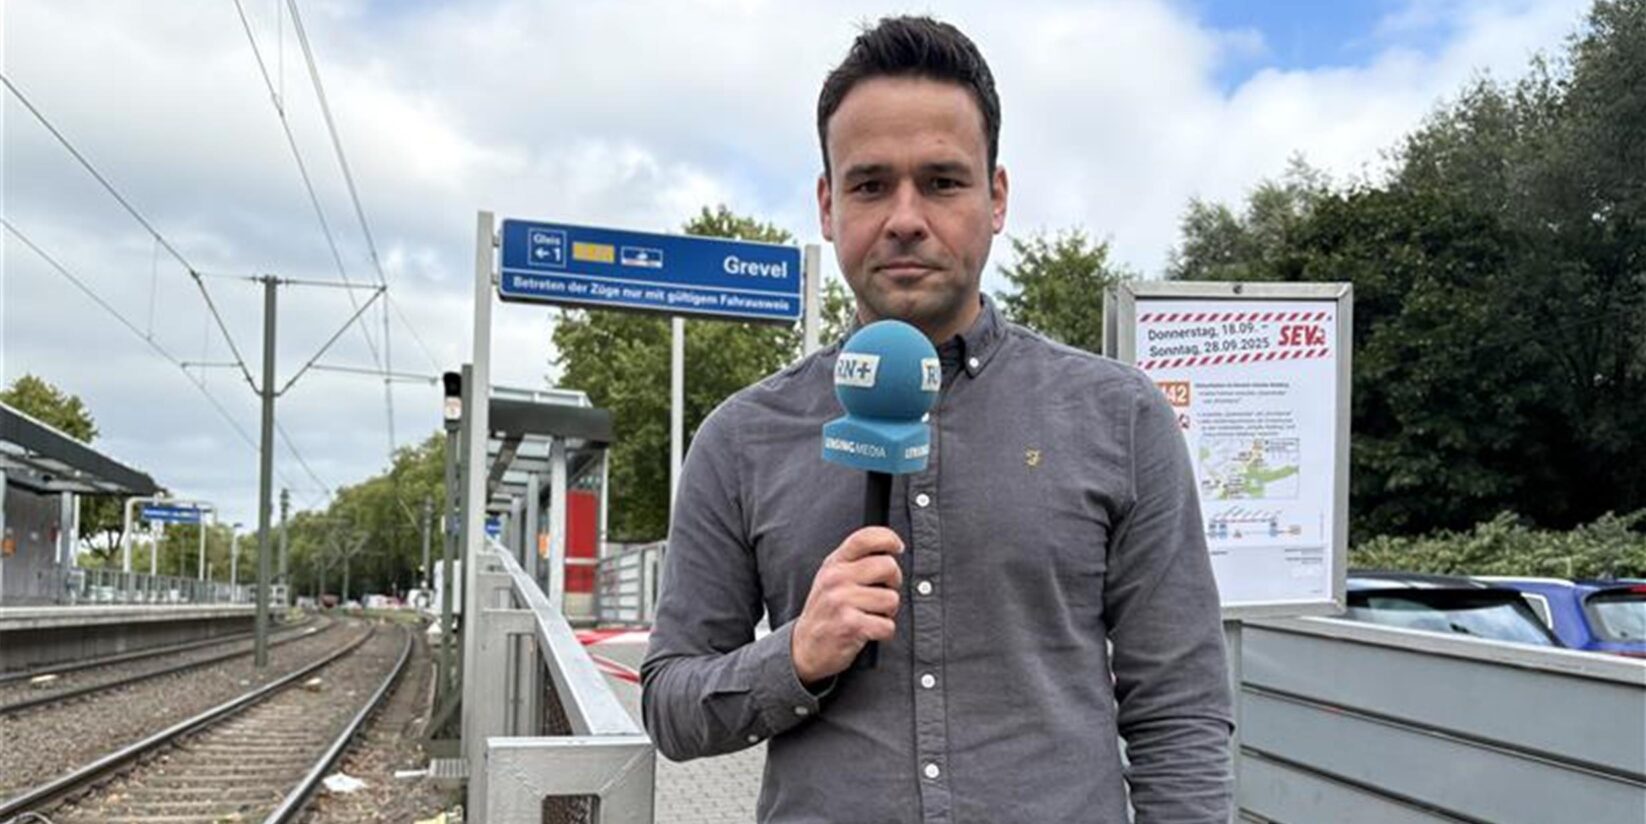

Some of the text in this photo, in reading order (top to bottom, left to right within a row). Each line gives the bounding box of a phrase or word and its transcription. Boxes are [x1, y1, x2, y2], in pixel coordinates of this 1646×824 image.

[533, 232, 561, 246] Gleis
[553, 247, 562, 262] 1
[723, 255, 788, 279] Grevel
[513, 276, 566, 291] Betreten
[567, 281, 588, 292] der
[623, 287, 642, 298] nur
[645, 288, 665, 300] mit
[667, 291, 719, 306] gültigem
[720, 294, 790, 312] Fahrausweis
[1148, 325, 1219, 341] Donnerstag,
[1204, 337, 1270, 354] 28.09.2025
[1162, 384, 1188, 403] 42
